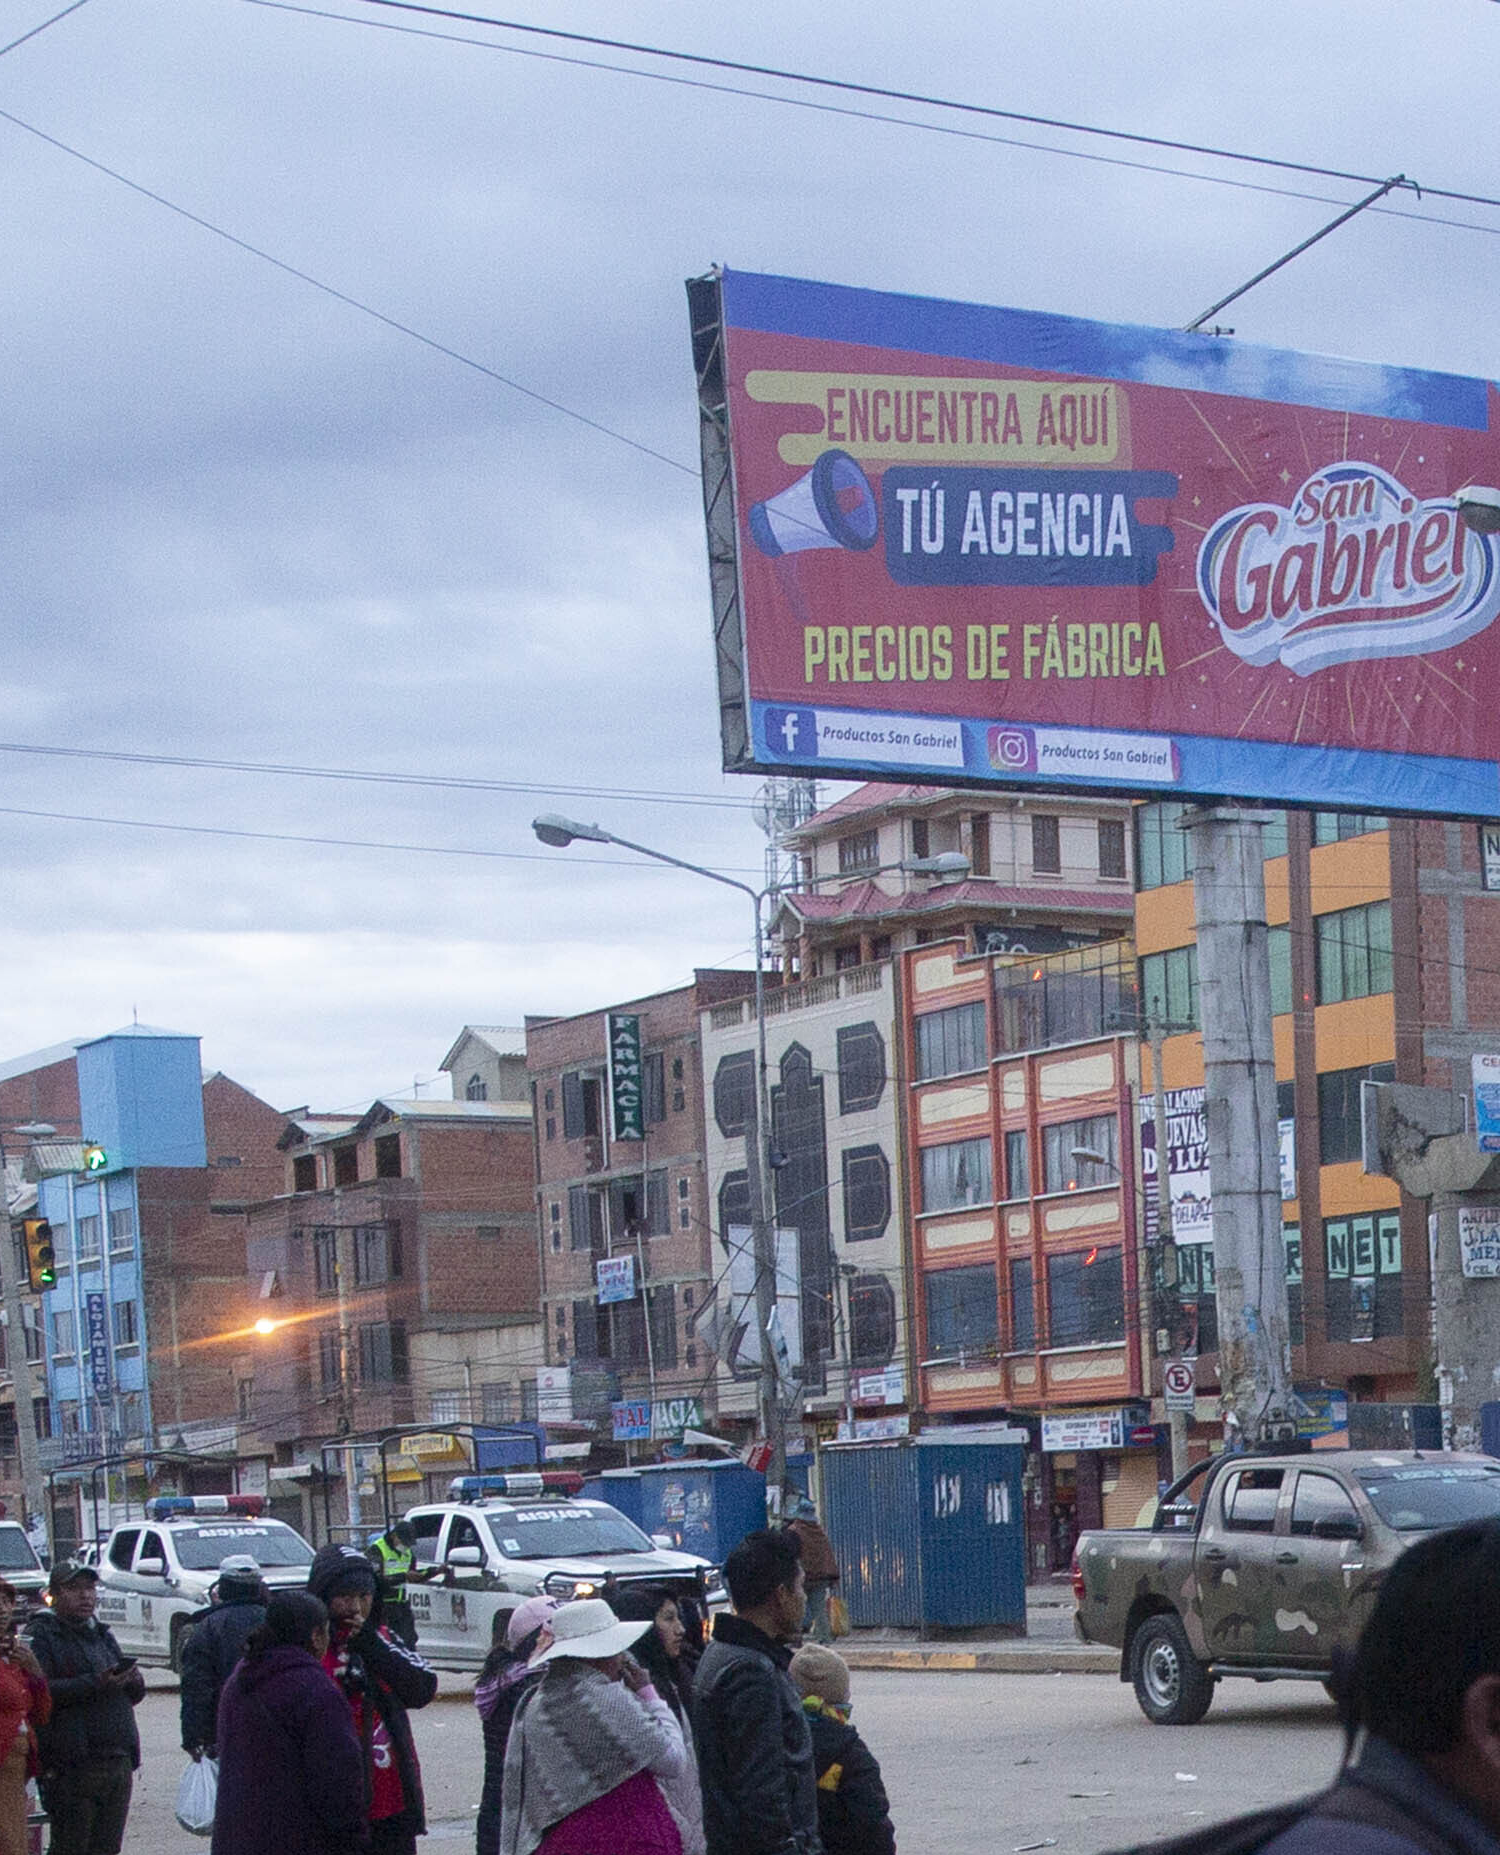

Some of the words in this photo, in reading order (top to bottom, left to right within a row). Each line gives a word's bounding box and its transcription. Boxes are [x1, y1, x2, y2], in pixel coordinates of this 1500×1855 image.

[827, 387, 1023, 444] ENCUENTRA
[1036, 387, 1109, 451] AQUÍ
[896, 481, 945, 555] TÚ
[960, 489, 1132, 557] AGENCIA
[1218, 497, 1466, 632] Gabriel
[804, 624, 953, 683] PRECIOS
[966, 623, 1010, 681] DE
[1023, 614, 1166, 680] FÁBRICA
[822, 726, 885, 744] Productos
[890, 732, 911, 745] San
[913, 733, 957, 749] Gabriel
[1042, 744, 1100, 761] Productos
[1103, 748, 1122, 761] San
[1127, 748, 1167, 766] Gabriel
[614, 1016, 641, 1138] FARMACIA
[1166, 1114, 1207, 1147] UEVAS
[89, 1295, 108, 1392] ALOJAMIENTO
